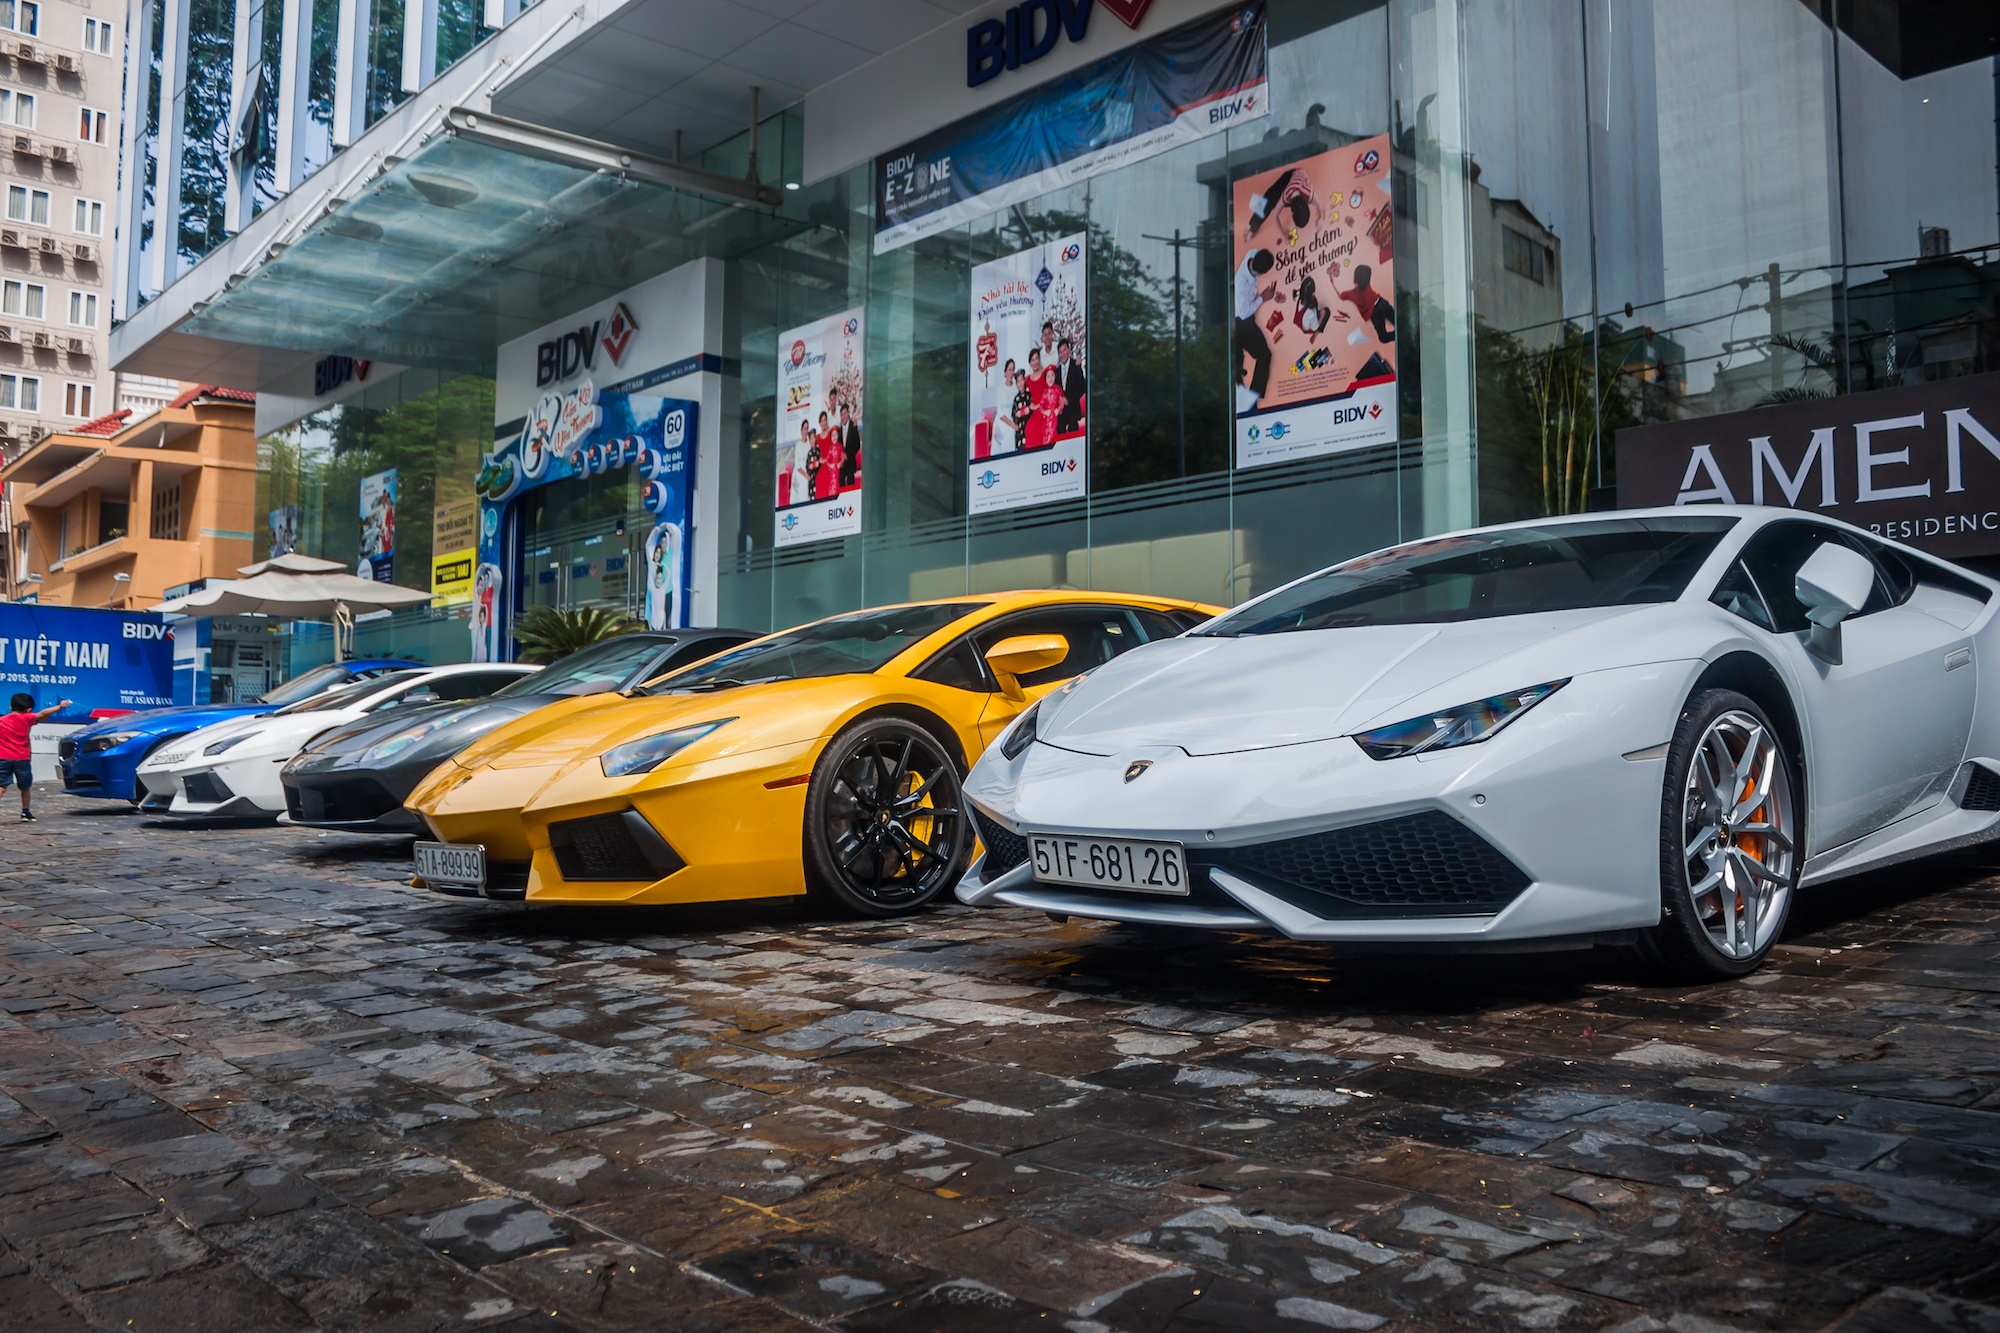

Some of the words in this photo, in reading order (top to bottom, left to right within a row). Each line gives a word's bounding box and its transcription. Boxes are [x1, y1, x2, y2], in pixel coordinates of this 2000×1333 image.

[967, 0, 1094, 88] BIDV
[1209, 98, 1242, 124] BIDV
[886, 152, 915, 178] BIDV
[1061, 244, 1080, 262] 60
[1275, 245, 1307, 271] Sống
[1308, 227, 1343, 252] chậm
[1299, 260, 1317, 278] yêu
[1318, 236, 1358, 267] thương
[977, 304, 994, 320] Đón
[995, 299, 1007, 311] yêu
[1009, 295, 1034, 308] thương
[981, 286, 1001, 309] Nhà
[1003, 281, 1014, 295] tài
[1016, 280, 1029, 296] lộc
[537, 320, 601, 388] BIDV
[314, 353, 353, 396] BIDV
[667, 414, 682, 435] 60
[1333, 405, 1367, 425] BIDV
[1041, 459, 1067, 476] BIDV
[1674, 407, 2000, 507] AMEN
[828, 507, 846, 520] BIDV
[436, 566, 456, 576] WESTERN
[122, 622, 167, 641] BIDV
[14, 633, 61, 671] VIỆT
[65, 641, 109, 669] NAM
[7, 673, 29, 684] 2015,
[30, 674, 49, 684] 2016
[50, 675, 56, 684] &
[58, 675, 77, 685] 2017
[120, 695, 134, 704] THE
[134, 696, 156, 705] ASIAN
[416, 849, 480, 879] 51A-899.99
[1033, 839, 1180, 887] 51F-681.26
